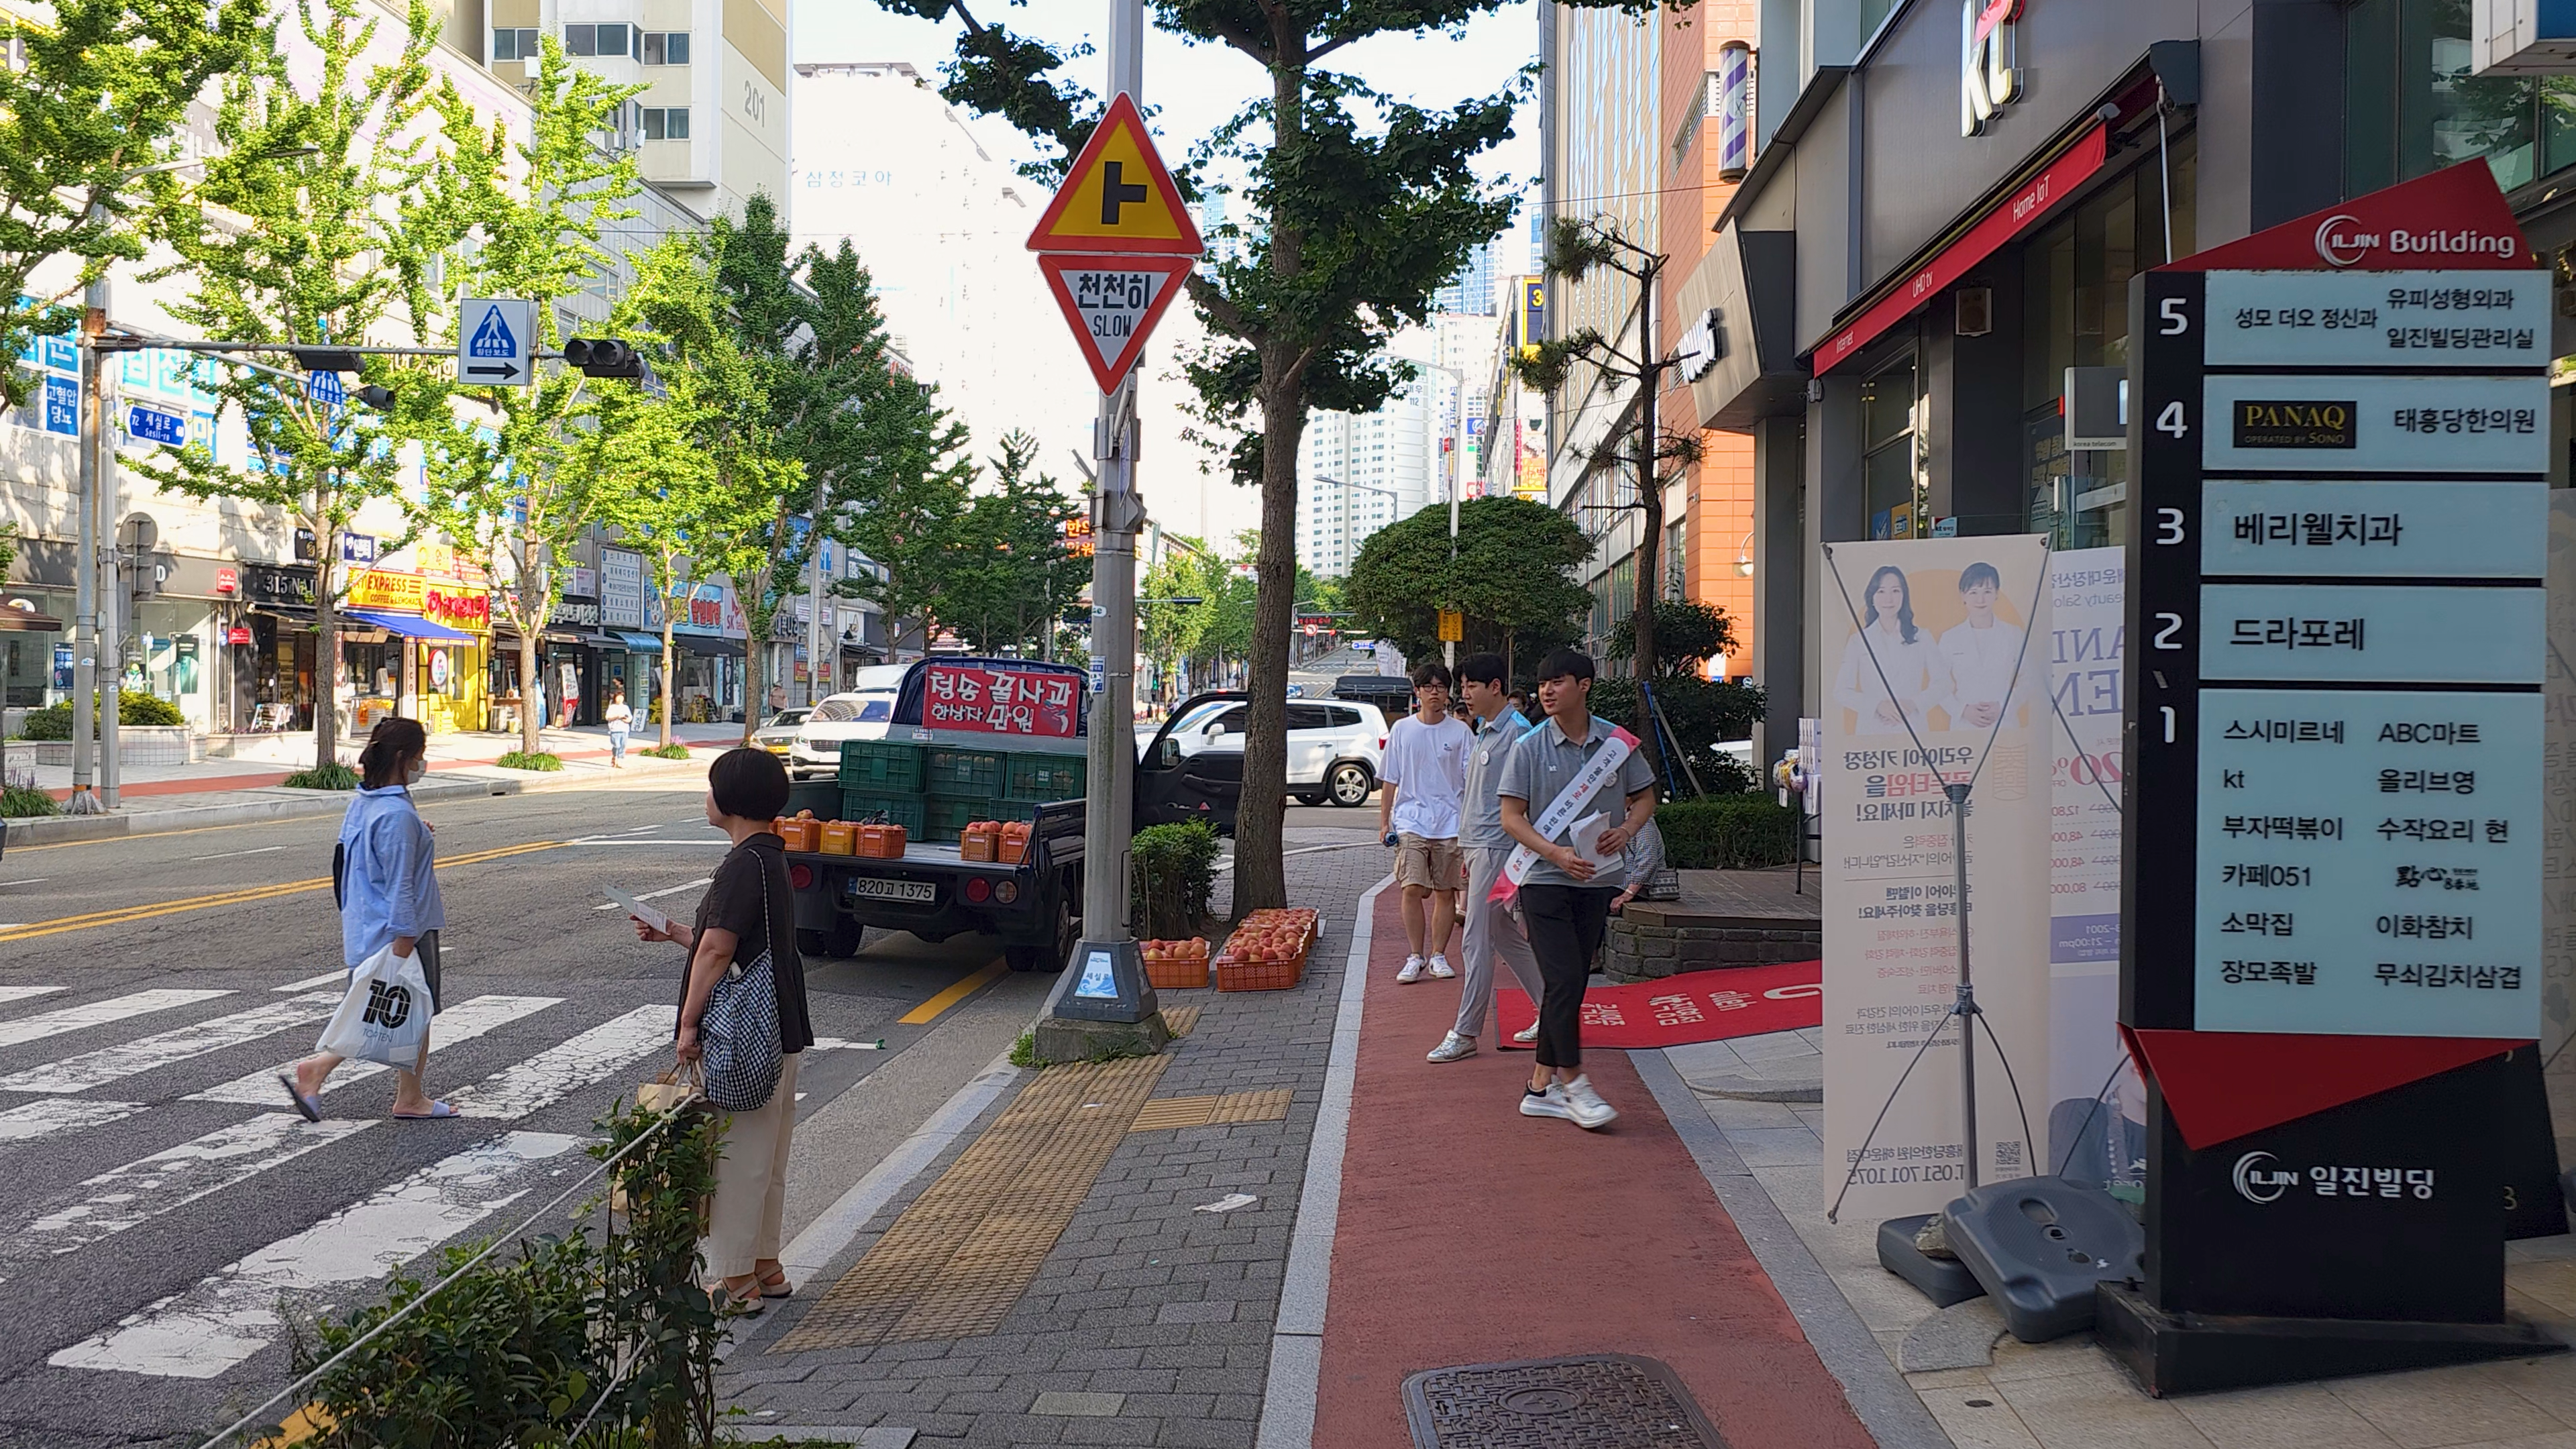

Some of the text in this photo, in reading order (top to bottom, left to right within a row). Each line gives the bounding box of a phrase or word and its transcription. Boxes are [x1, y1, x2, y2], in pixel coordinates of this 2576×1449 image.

[744, 80, 766, 127] 201
[806, 170, 892, 188] 삼정코아
[2013, 191, 2035, 223] Home
[2331, 229, 2516, 259] ILJIN Building
[1078, 273, 1151, 309] 천천히
[1913, 271, 1933, 298] UHD tv
[2387, 288, 2514, 310] 유피성형외과
[1093, 315, 1132, 337] SLOW
[2159, 298, 2189, 335] 5
[2236, 308, 2378, 329] 성모 더오 정신과
[1835, 332, 1854, 354] Internet
[2387, 327, 2535, 350] 일진빌딩관리실
[477, 347, 509, 357] 횡단보도
[47, 386, 77, 407] 고혈압
[1409, 397, 1419, 406] 112
[52, 407, 72, 425] 당뇨
[146, 412, 171, 430] 세실로
[2155, 400, 2188, 439] 4
[2245, 406, 2346, 431] PANAQ
[2394, 409, 2535, 434] 태흥당한의원
[2244, 435, 2292, 443] OPERATED
[2156, 508, 2185, 545] 3
[2235, 513, 2403, 546] 베리웰치과
[266, 575, 318, 596] 315 NAI
[368, 575, 407, 592] EXPRESS
[370, 594, 390, 603] COFFEE
[394, 596, 422, 606] LEMONADE
[727, 614, 735, 630] SK
[2154, 613, 2183, 649] 2
[2230, 618, 2364, 649] 드라포레
[929, 671, 981, 701] 청송
[985, 669, 1073, 707] 꿀사과
[931, 702, 1034, 733] 한상자 만원
[2159, 706, 2176, 744] 1
[2224, 720, 2344, 745] 스시미르네
[2378, 722, 2481, 745] ABC마트
[2224, 769, 2245, 790] kt
[2377, 769, 2475, 794] 올리브영
[2222, 816, 2343, 841] 부자떡볶이
[2377, 819, 2509, 843] 수작요리 현
[2222, 864, 2312, 888] 카페051
[858, 879, 932, 899] 820고 1375
[2221, 912, 2294, 936] 소막집
[2377, 915, 2473, 940] 이화참치
[2220, 960, 2317, 986] 장모족발
[2374, 964, 2522, 990] 무쇠김치삼겹
[362, 979, 411, 1029] 10
[2250, 1166, 2434, 1199] ILJIN 일진빌딩
